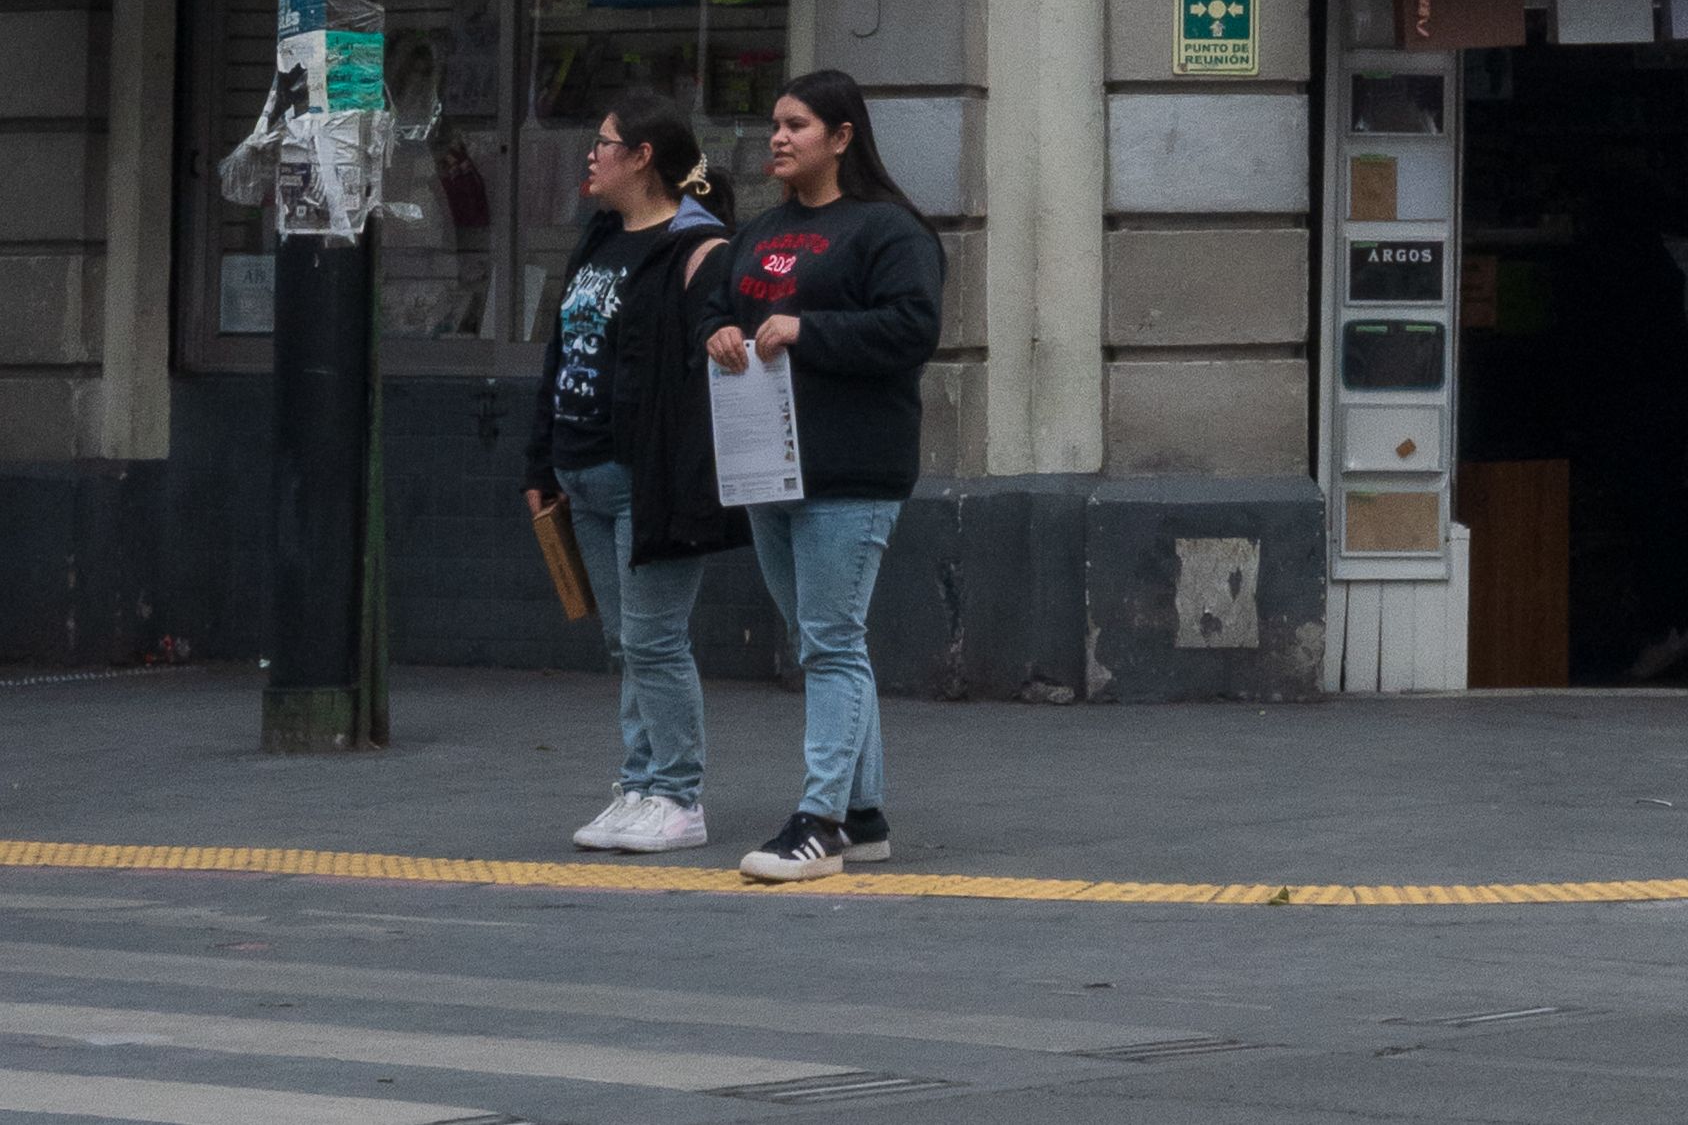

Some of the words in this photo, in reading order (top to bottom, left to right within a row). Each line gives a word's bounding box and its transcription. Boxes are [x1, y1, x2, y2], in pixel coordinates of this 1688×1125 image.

[1184, 43, 1229, 53] PUNTO
[1232, 43, 1249, 53] DE
[1368, 248, 1434, 264] ARGOS
